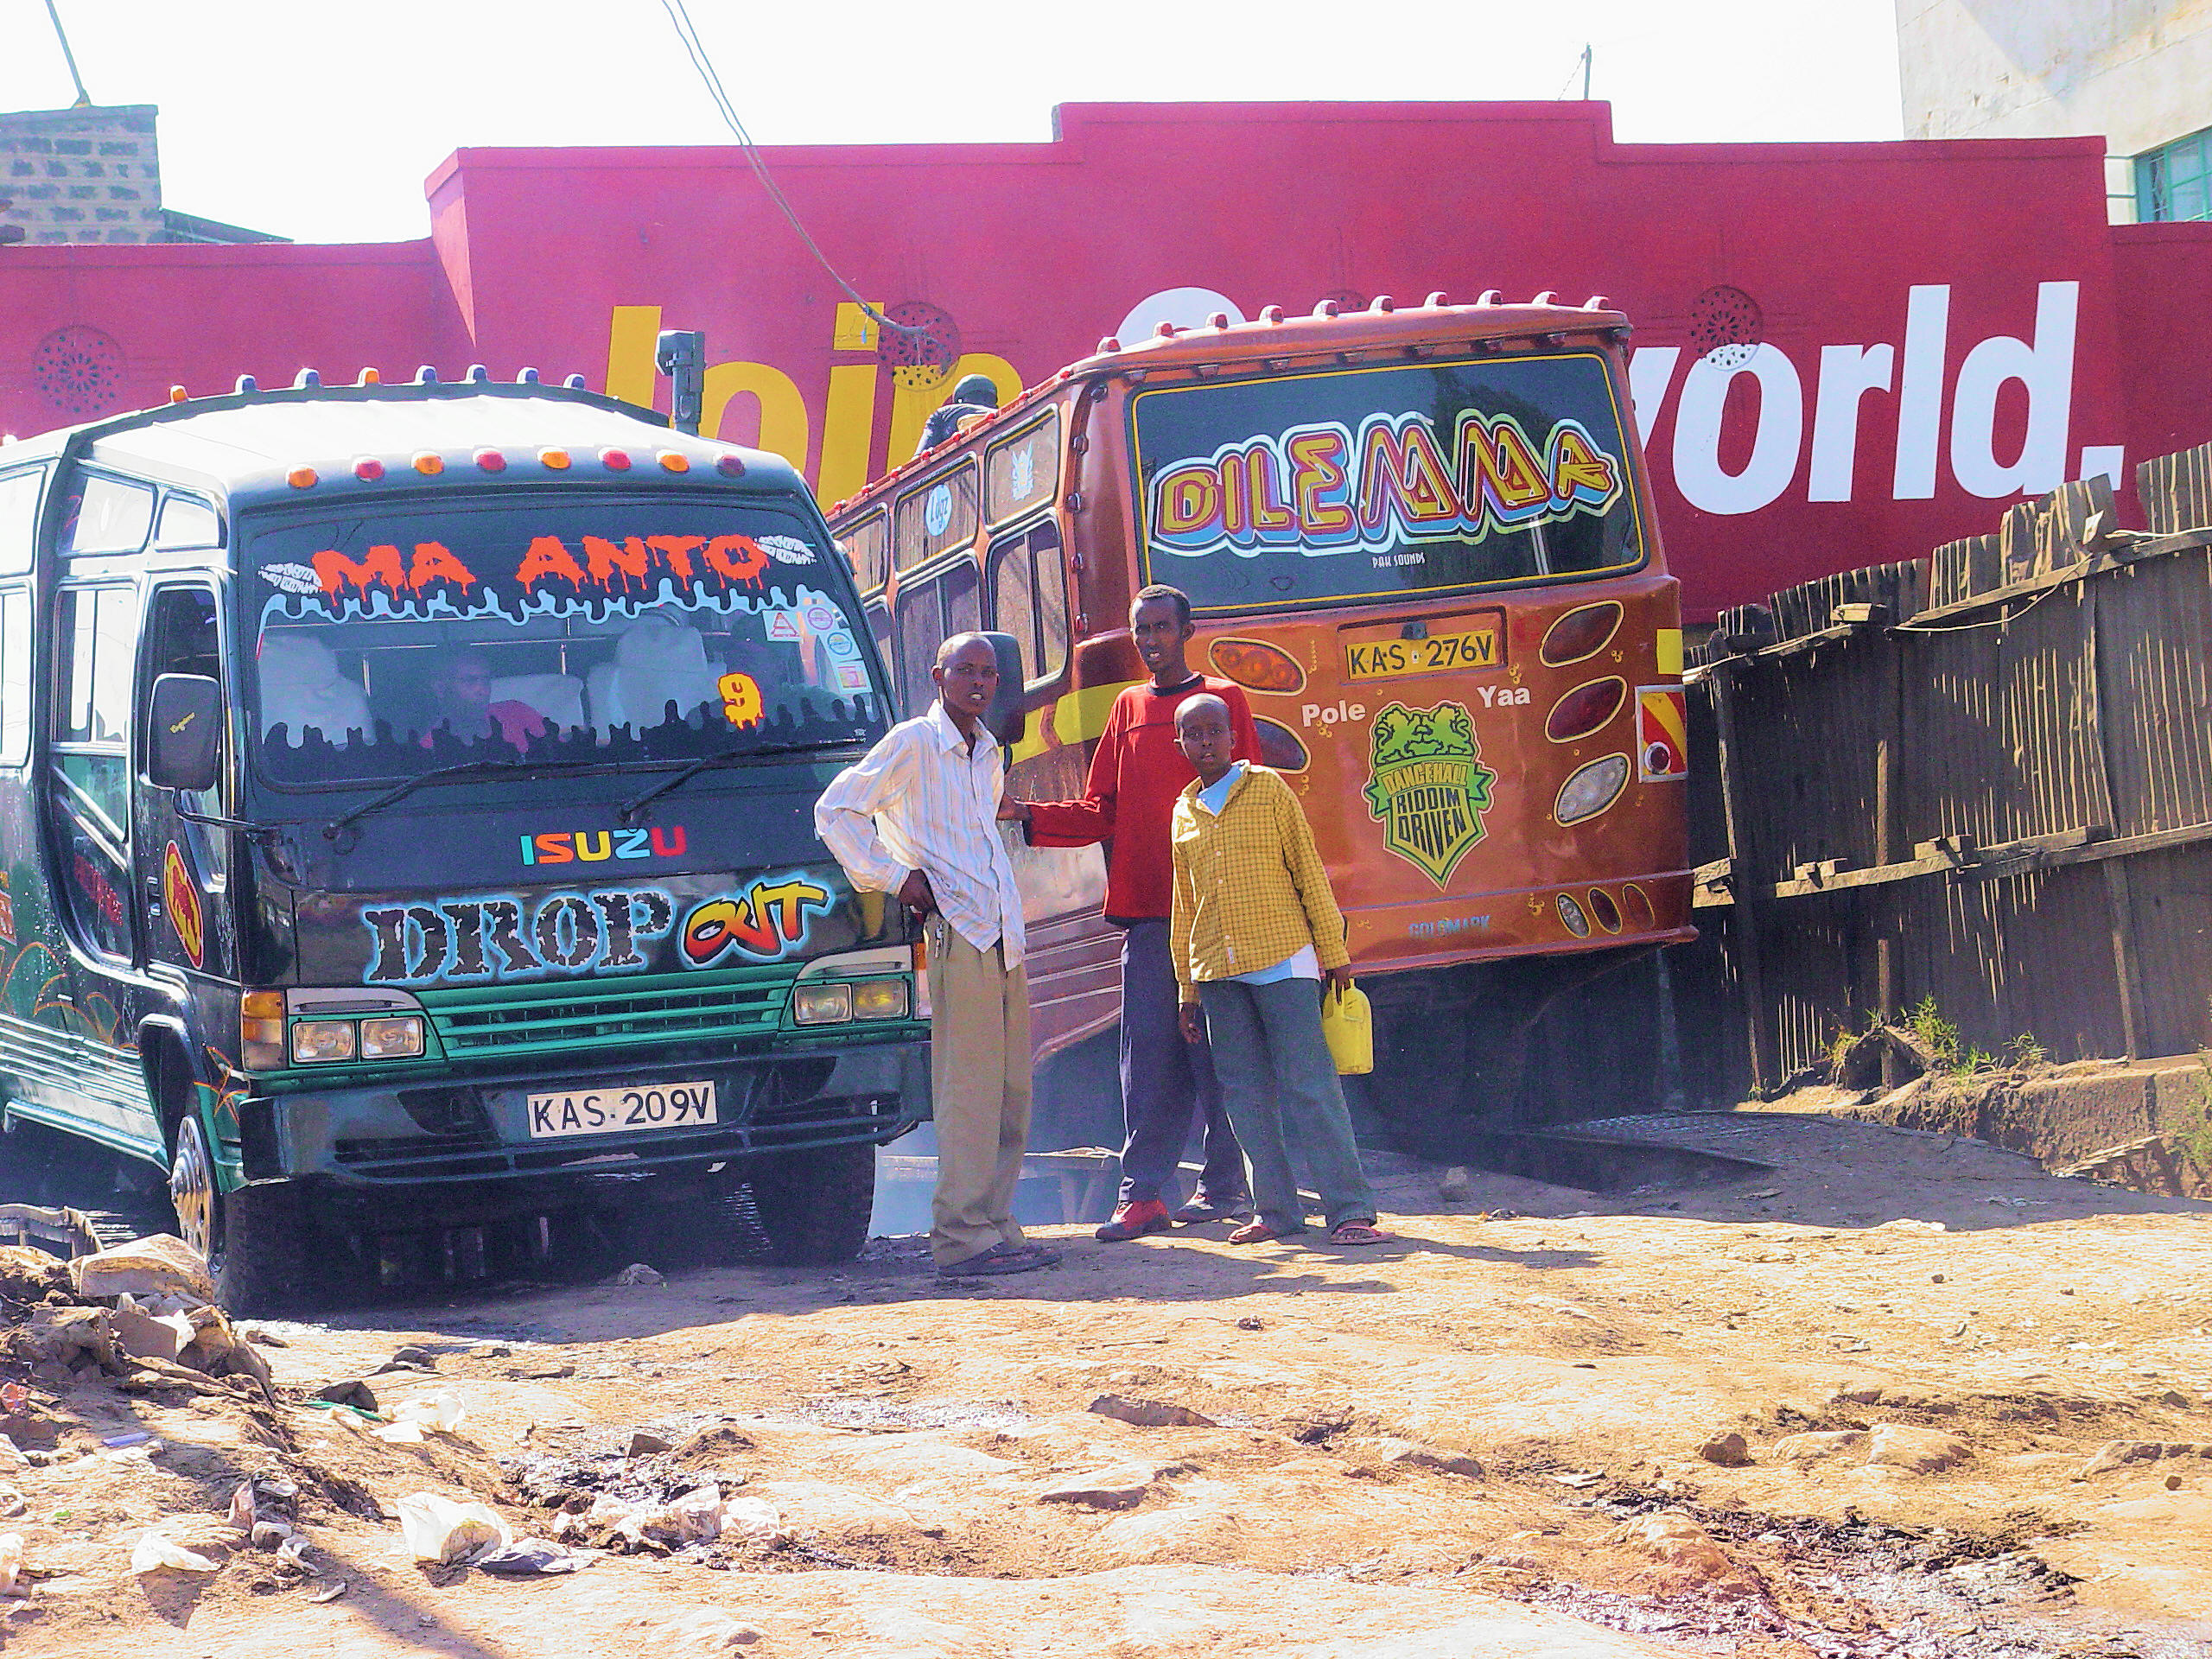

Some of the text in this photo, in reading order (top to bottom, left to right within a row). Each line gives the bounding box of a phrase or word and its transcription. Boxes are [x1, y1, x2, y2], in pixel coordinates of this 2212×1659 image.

[1629, 280, 2125, 515] orld.
[1151, 411, 1619, 553] DILEMMA
[311, 535, 772, 607] MA ANTO
[1350, 634, 1492, 675] KAS 276V
[718, 672, 765, 730] 9
[1301, 685, 1531, 727] Pole Yaa
[1382, 762, 1469, 796] DANCEHALL
[1396, 787, 1461, 814] RIDDIM
[521, 826, 687, 865] ISUZU
[1397, 808, 1467, 861] DRIVEN
[363, 880, 830, 983] DROP OUT
[620, 1086, 710, 1125] 209V
